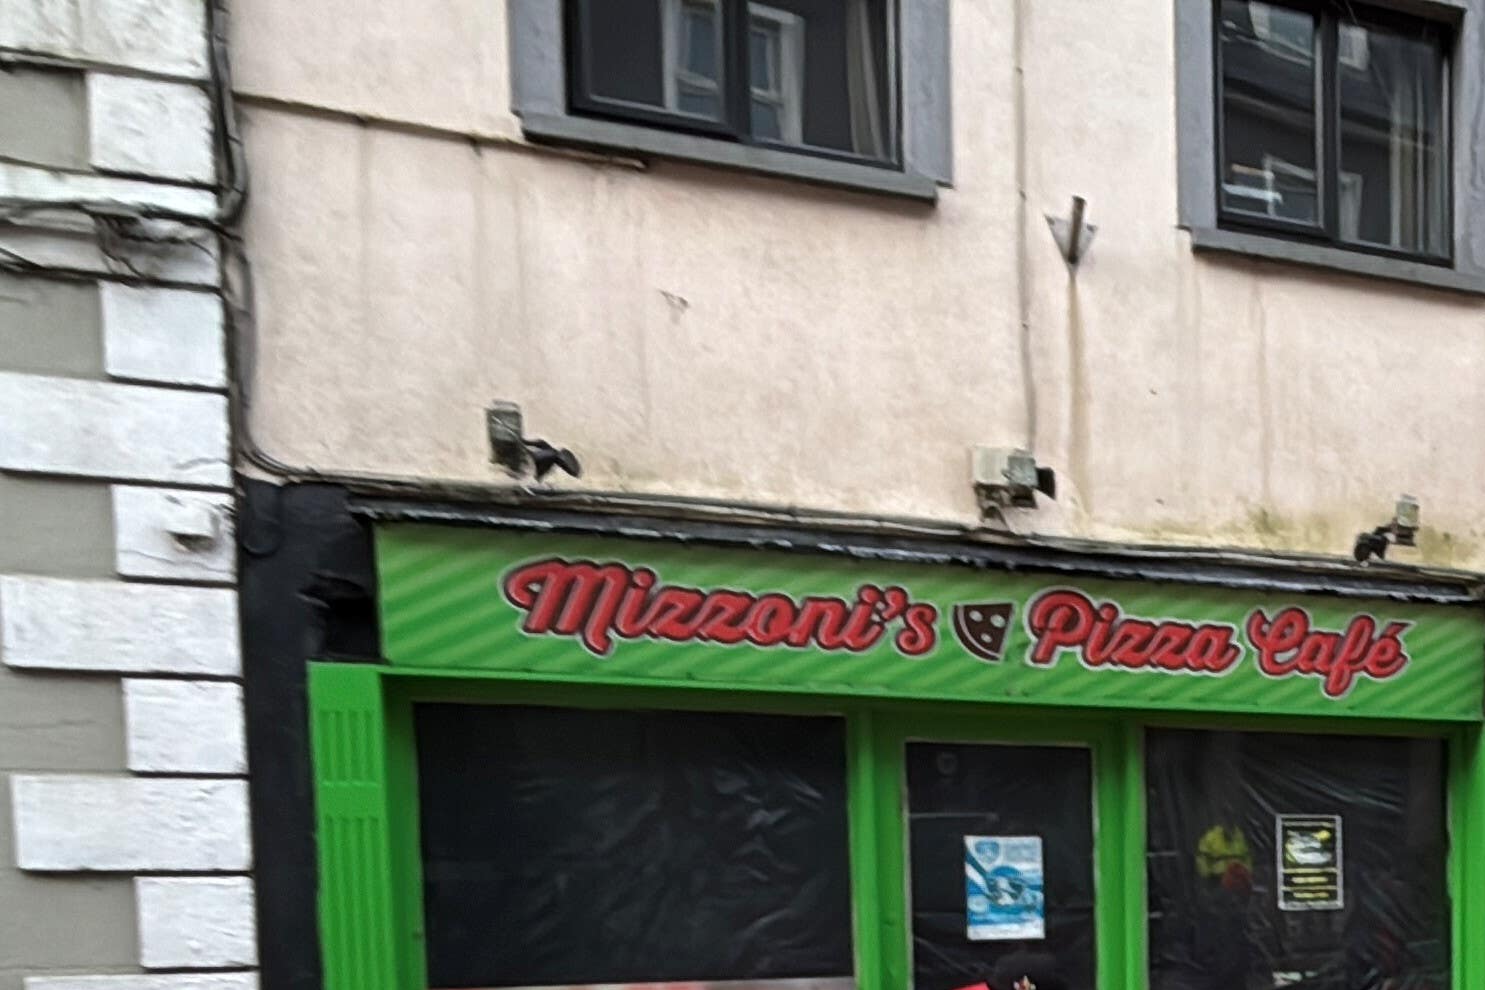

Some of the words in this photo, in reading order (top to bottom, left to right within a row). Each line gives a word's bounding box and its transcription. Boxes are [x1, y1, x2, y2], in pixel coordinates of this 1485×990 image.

[500, 556, 938, 659] Mizzoni's
[1027, 588, 1244, 677] Pizza
[1246, 605, 1415, 699] Café
